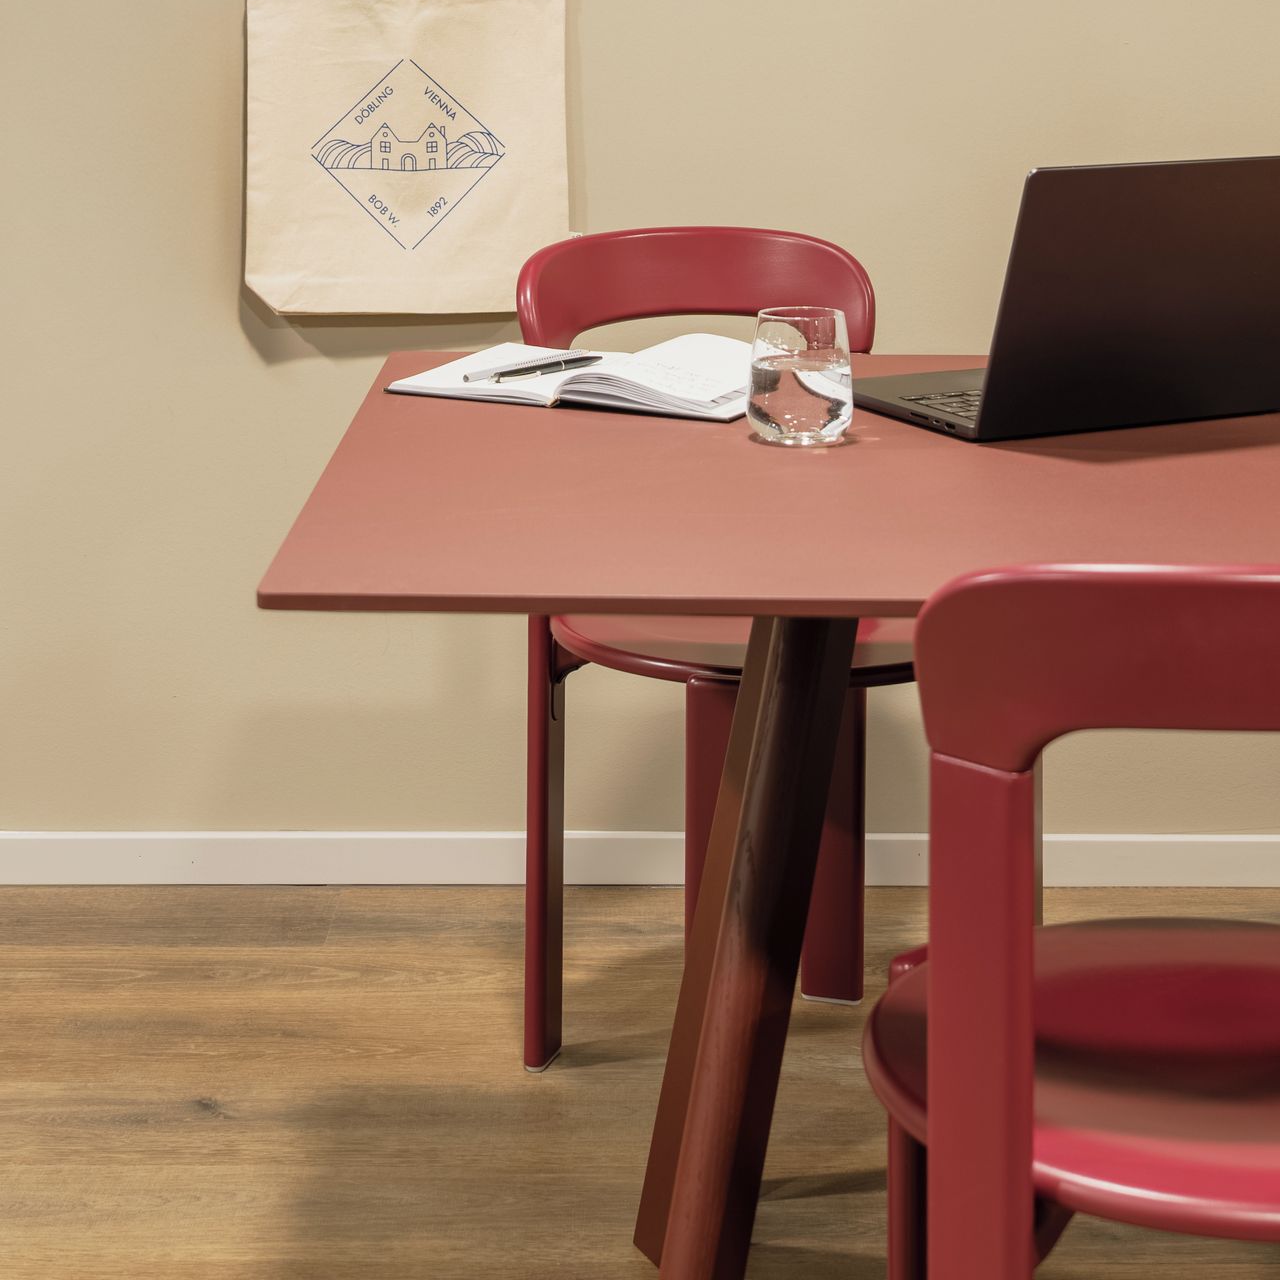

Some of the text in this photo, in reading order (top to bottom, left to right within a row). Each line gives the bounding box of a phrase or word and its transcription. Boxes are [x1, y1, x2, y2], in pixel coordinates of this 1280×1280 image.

[354, 85, 394, 125] DÖBLING
[423, 85, 457, 121] VIENNA
[367, 193, 388, 216] BOB
[426, 196, 449, 218] 1892
